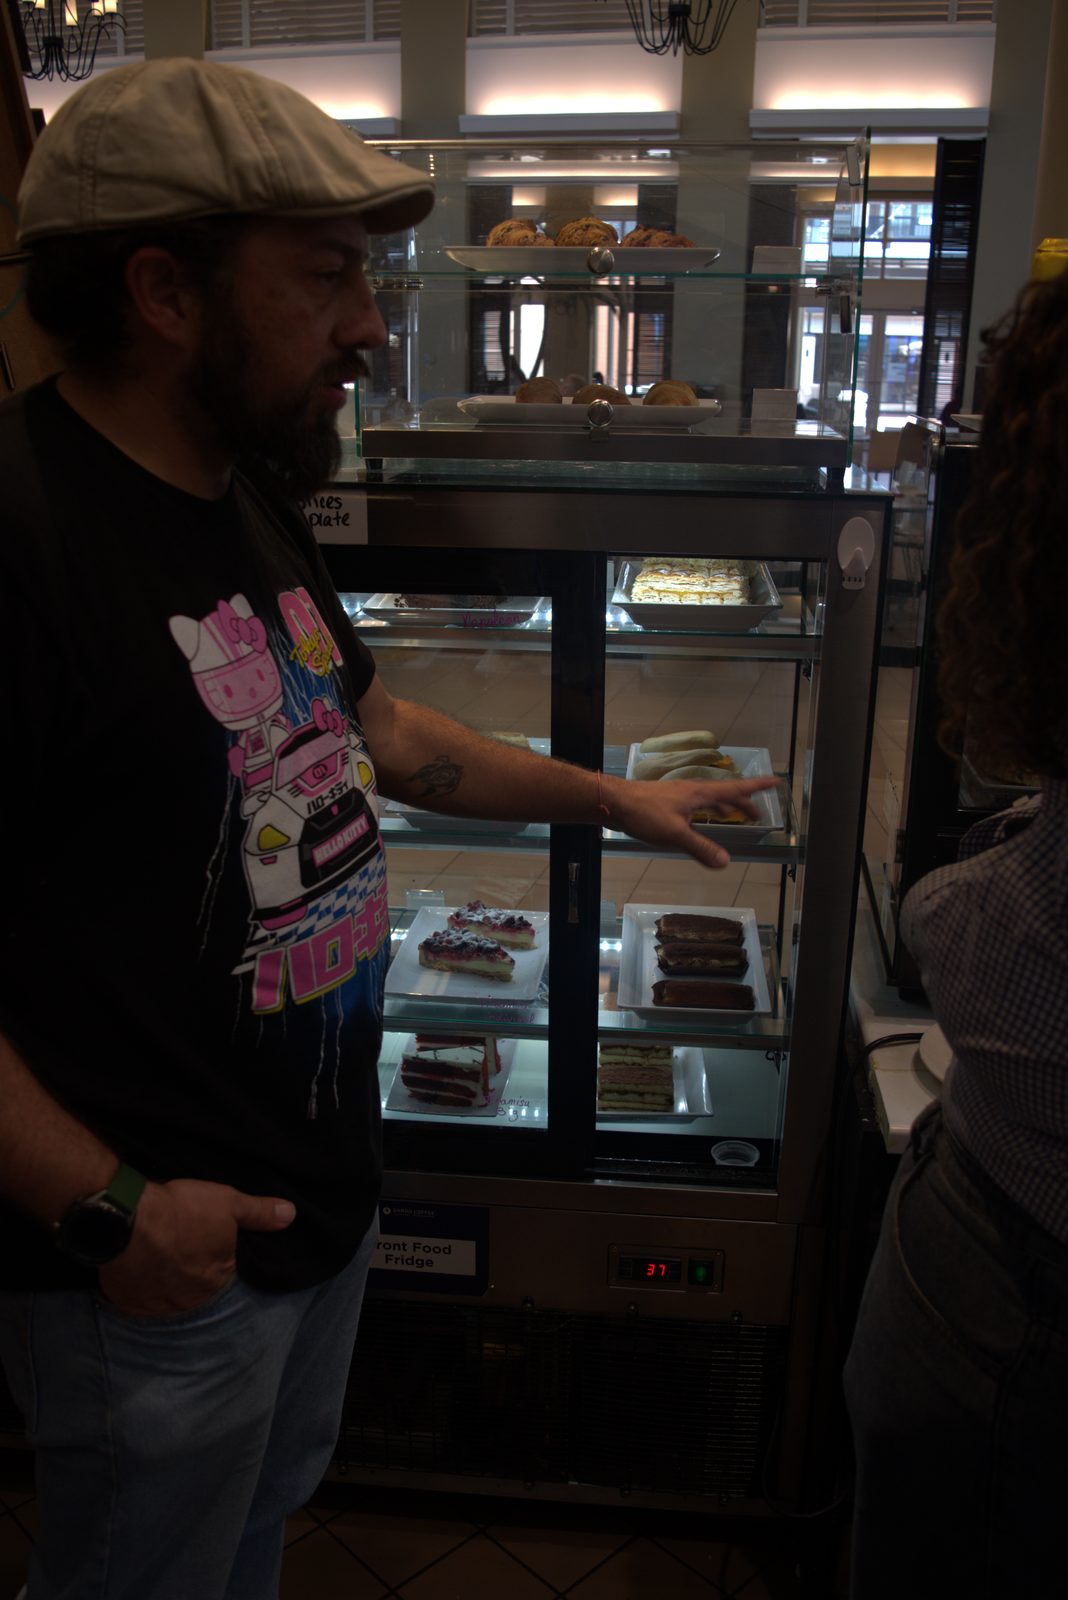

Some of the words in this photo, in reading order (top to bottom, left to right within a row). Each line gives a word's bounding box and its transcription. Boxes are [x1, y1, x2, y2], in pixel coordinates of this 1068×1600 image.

[308, 511, 350, 527] olate
[376, 1241, 408, 1252] ront
[413, 1242, 452, 1255] Food
[385, 1254, 434, 1268] Fridge
[646, 1263, 668, 1277] 37
